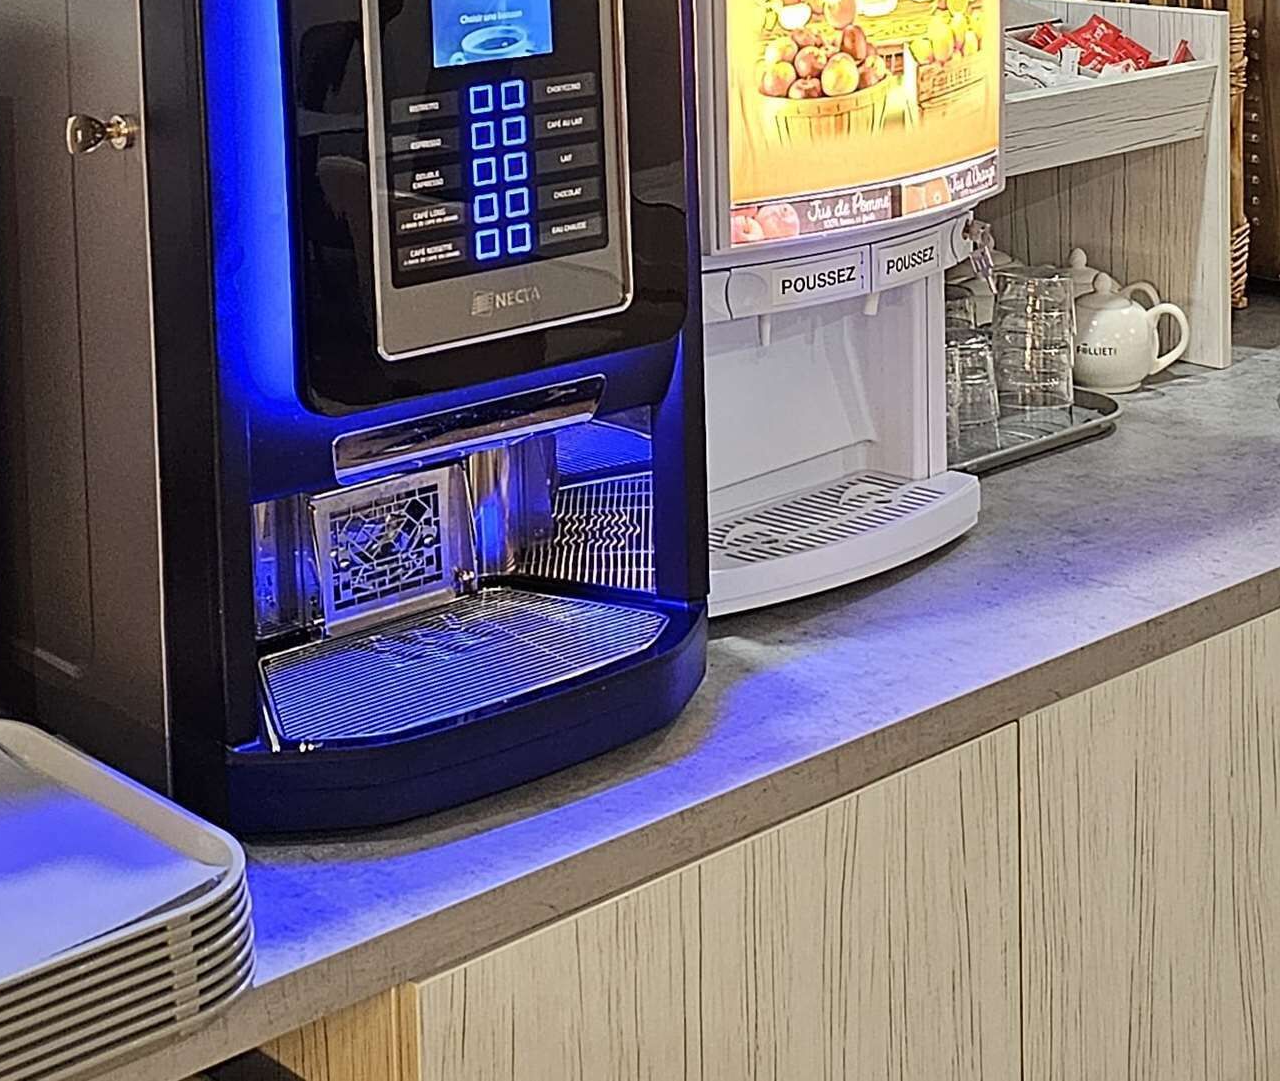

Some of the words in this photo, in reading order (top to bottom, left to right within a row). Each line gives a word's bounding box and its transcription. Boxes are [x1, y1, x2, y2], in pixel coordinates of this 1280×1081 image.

[807, 199, 831, 222] Jus
[834, 199, 850, 218] de
[886, 246, 935, 275] POUSSEZ
[781, 265, 857, 296] POUSSEZ
[495, 285, 541, 309] NECTA
